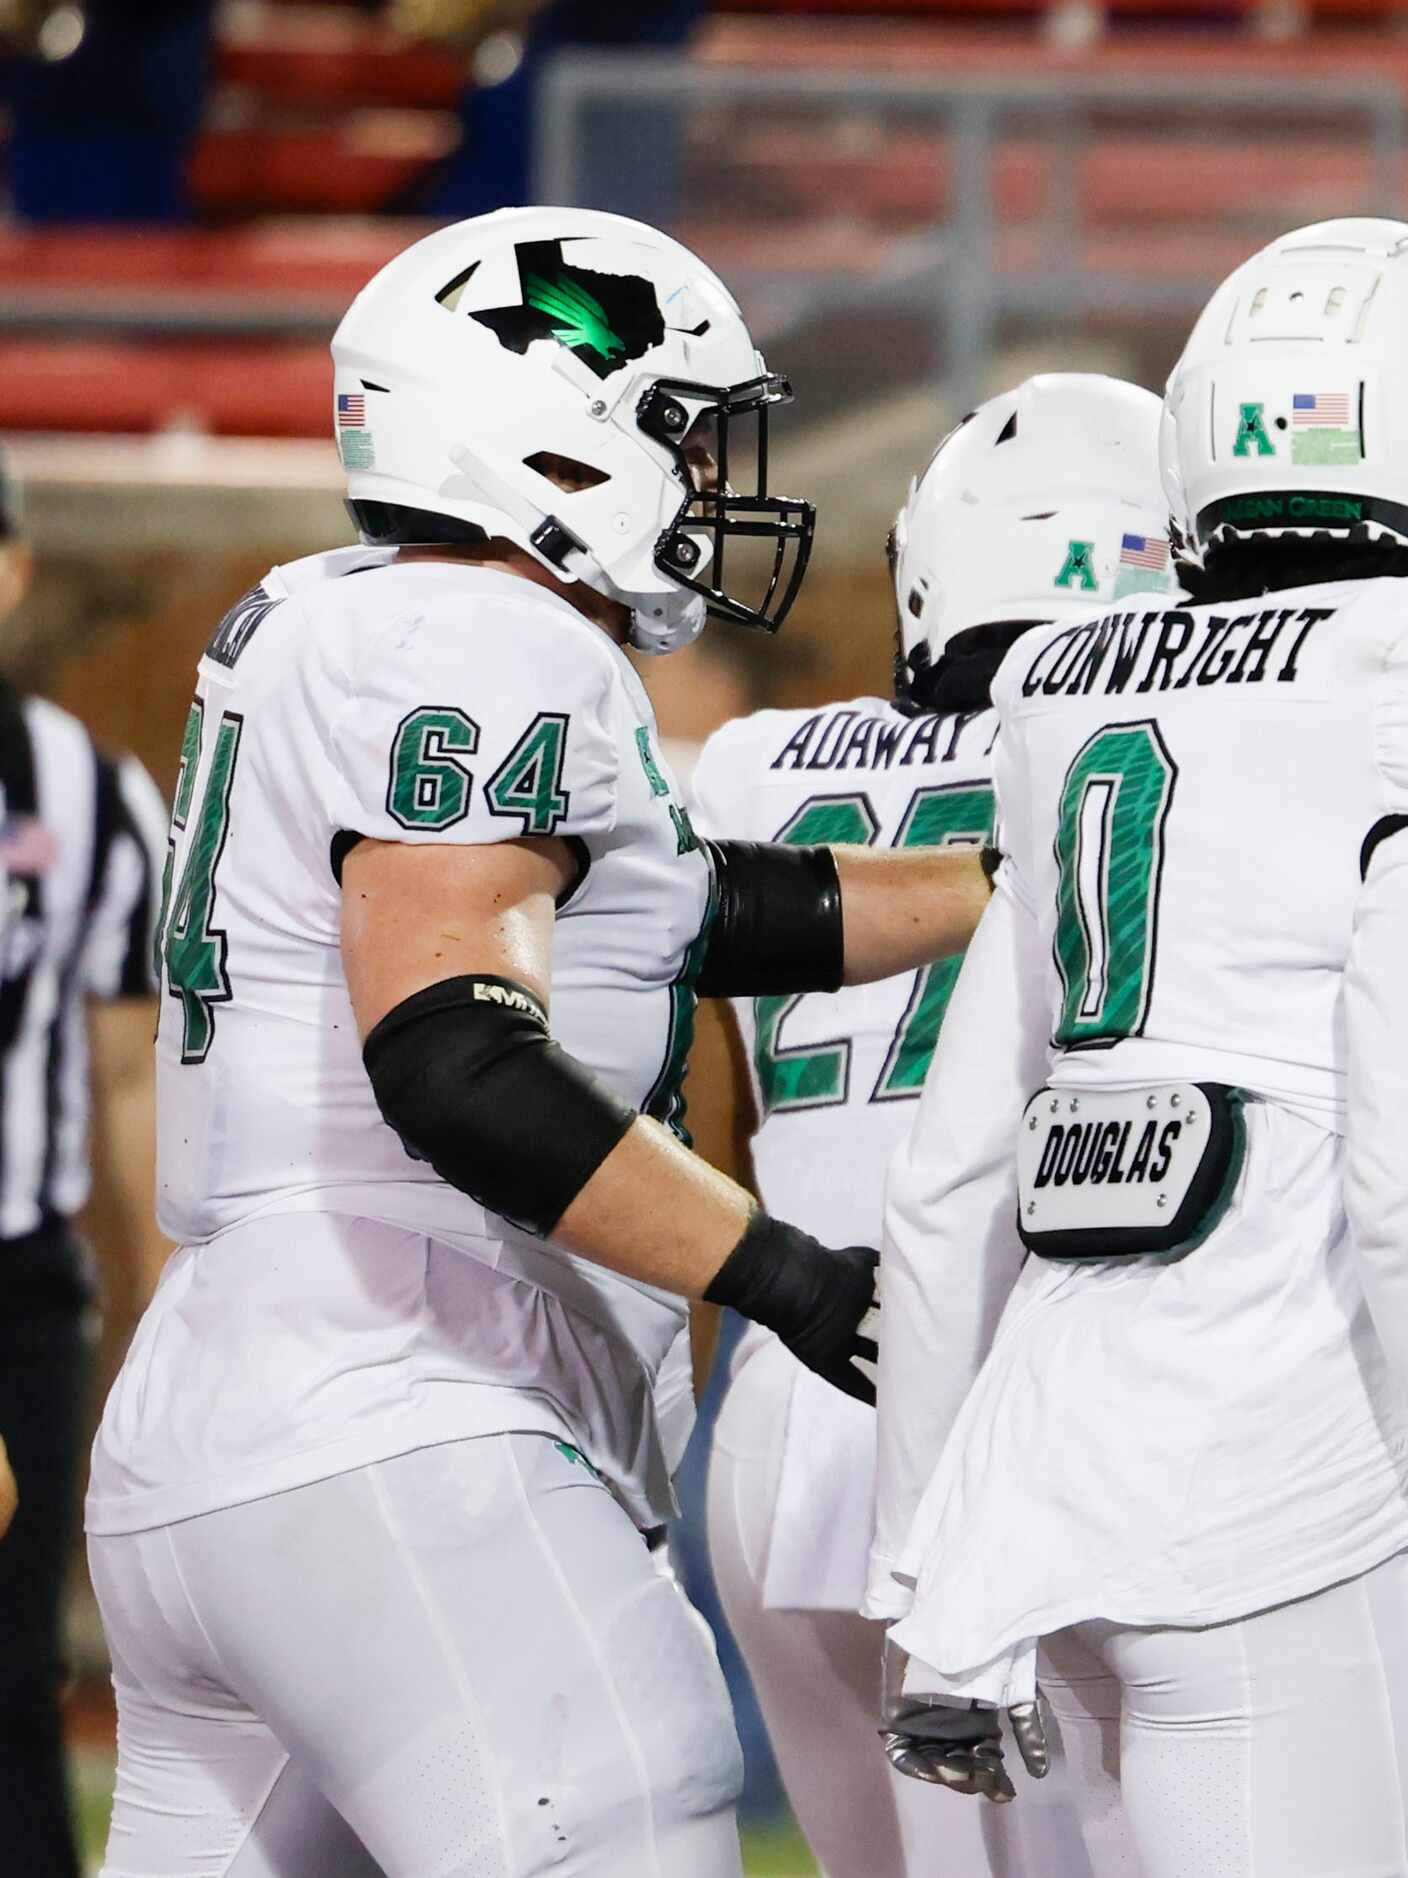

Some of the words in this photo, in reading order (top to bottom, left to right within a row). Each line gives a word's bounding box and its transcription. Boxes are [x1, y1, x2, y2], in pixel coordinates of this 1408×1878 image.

[1023, 608, 1335, 698] CONWRIGHT
[385, 705, 571, 836] 64
[770, 711, 982, 770] ADAWAY
[1050, 718, 1178, 1052] 0
[1034, 1120, 1182, 1188] DOUGLAS
